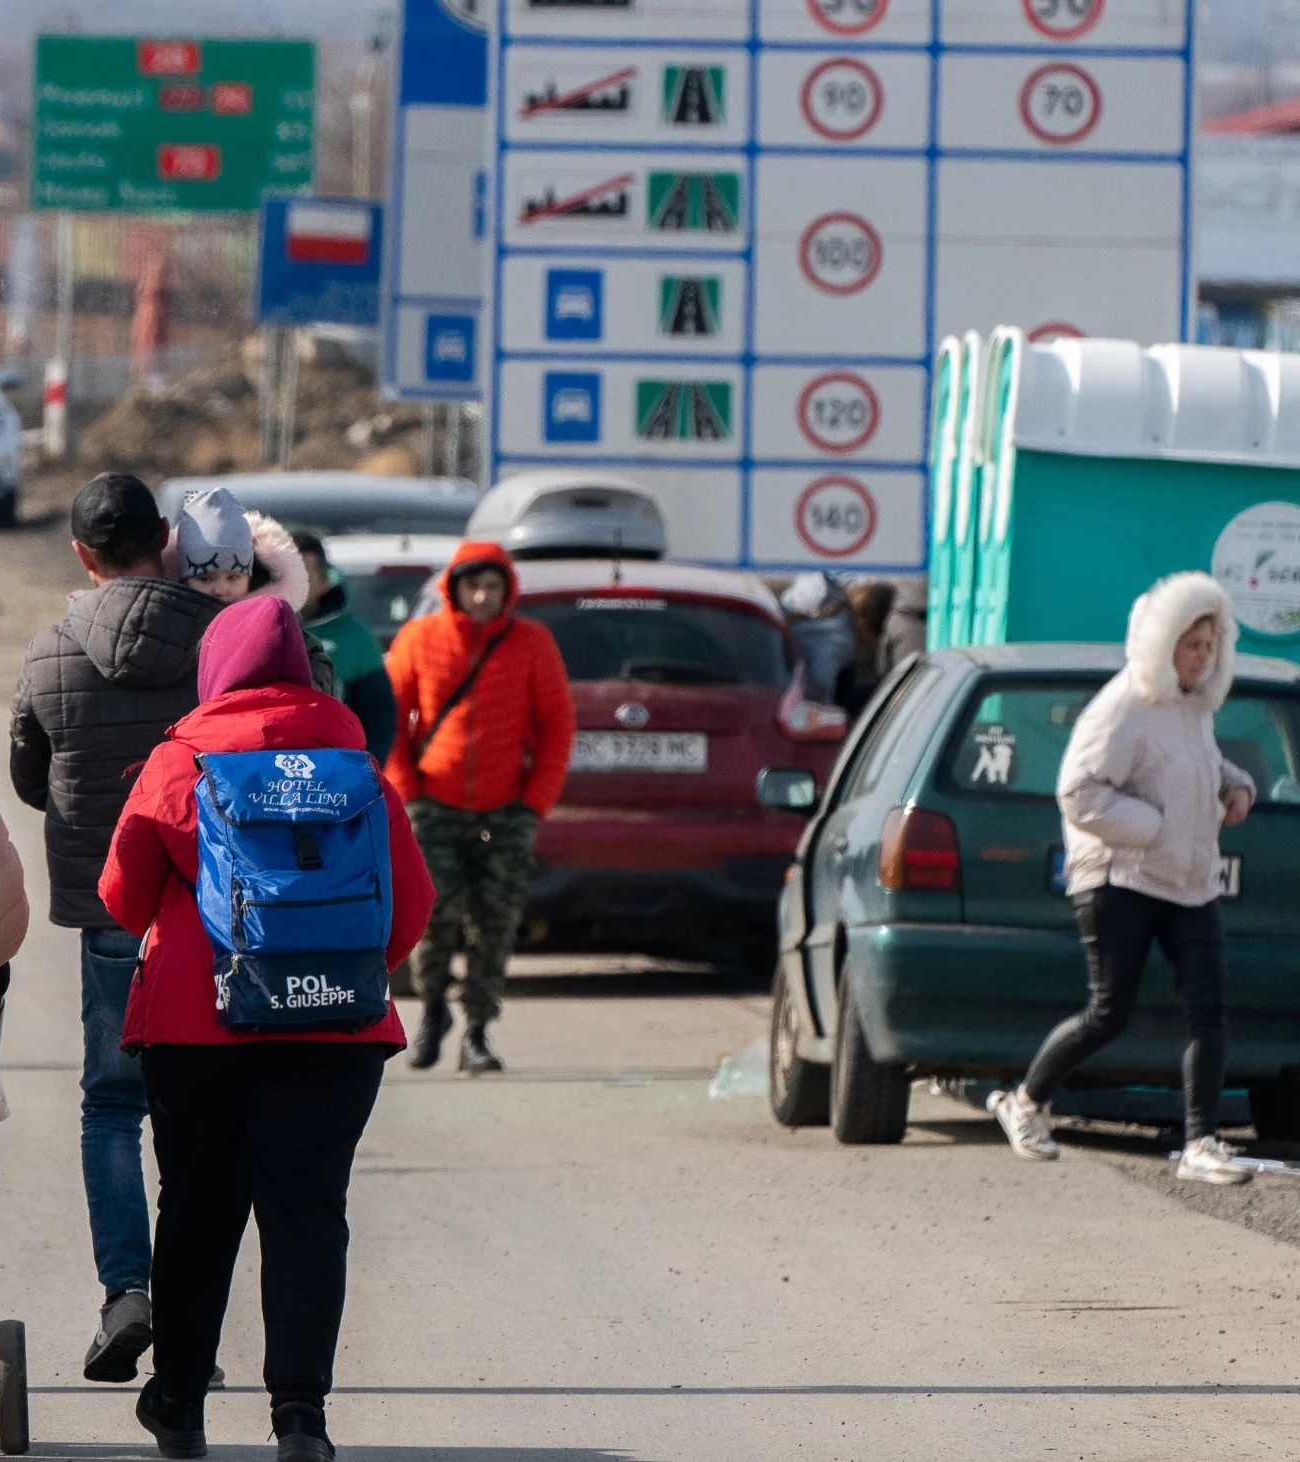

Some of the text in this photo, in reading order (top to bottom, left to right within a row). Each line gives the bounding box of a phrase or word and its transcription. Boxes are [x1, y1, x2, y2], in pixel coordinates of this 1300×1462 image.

[821, 82, 867, 116] 90
[1042, 83, 1084, 117] 70
[815, 236, 871, 273] 100
[814, 398, 866, 430] 120
[811, 502, 864, 535] 140
[248, 792, 349, 807] VILLA LINA
[267, 780, 326, 793] HOTEL
[270, 990, 355, 1010] S. GIUSEPPE
[286, 975, 341, 995] POL.
